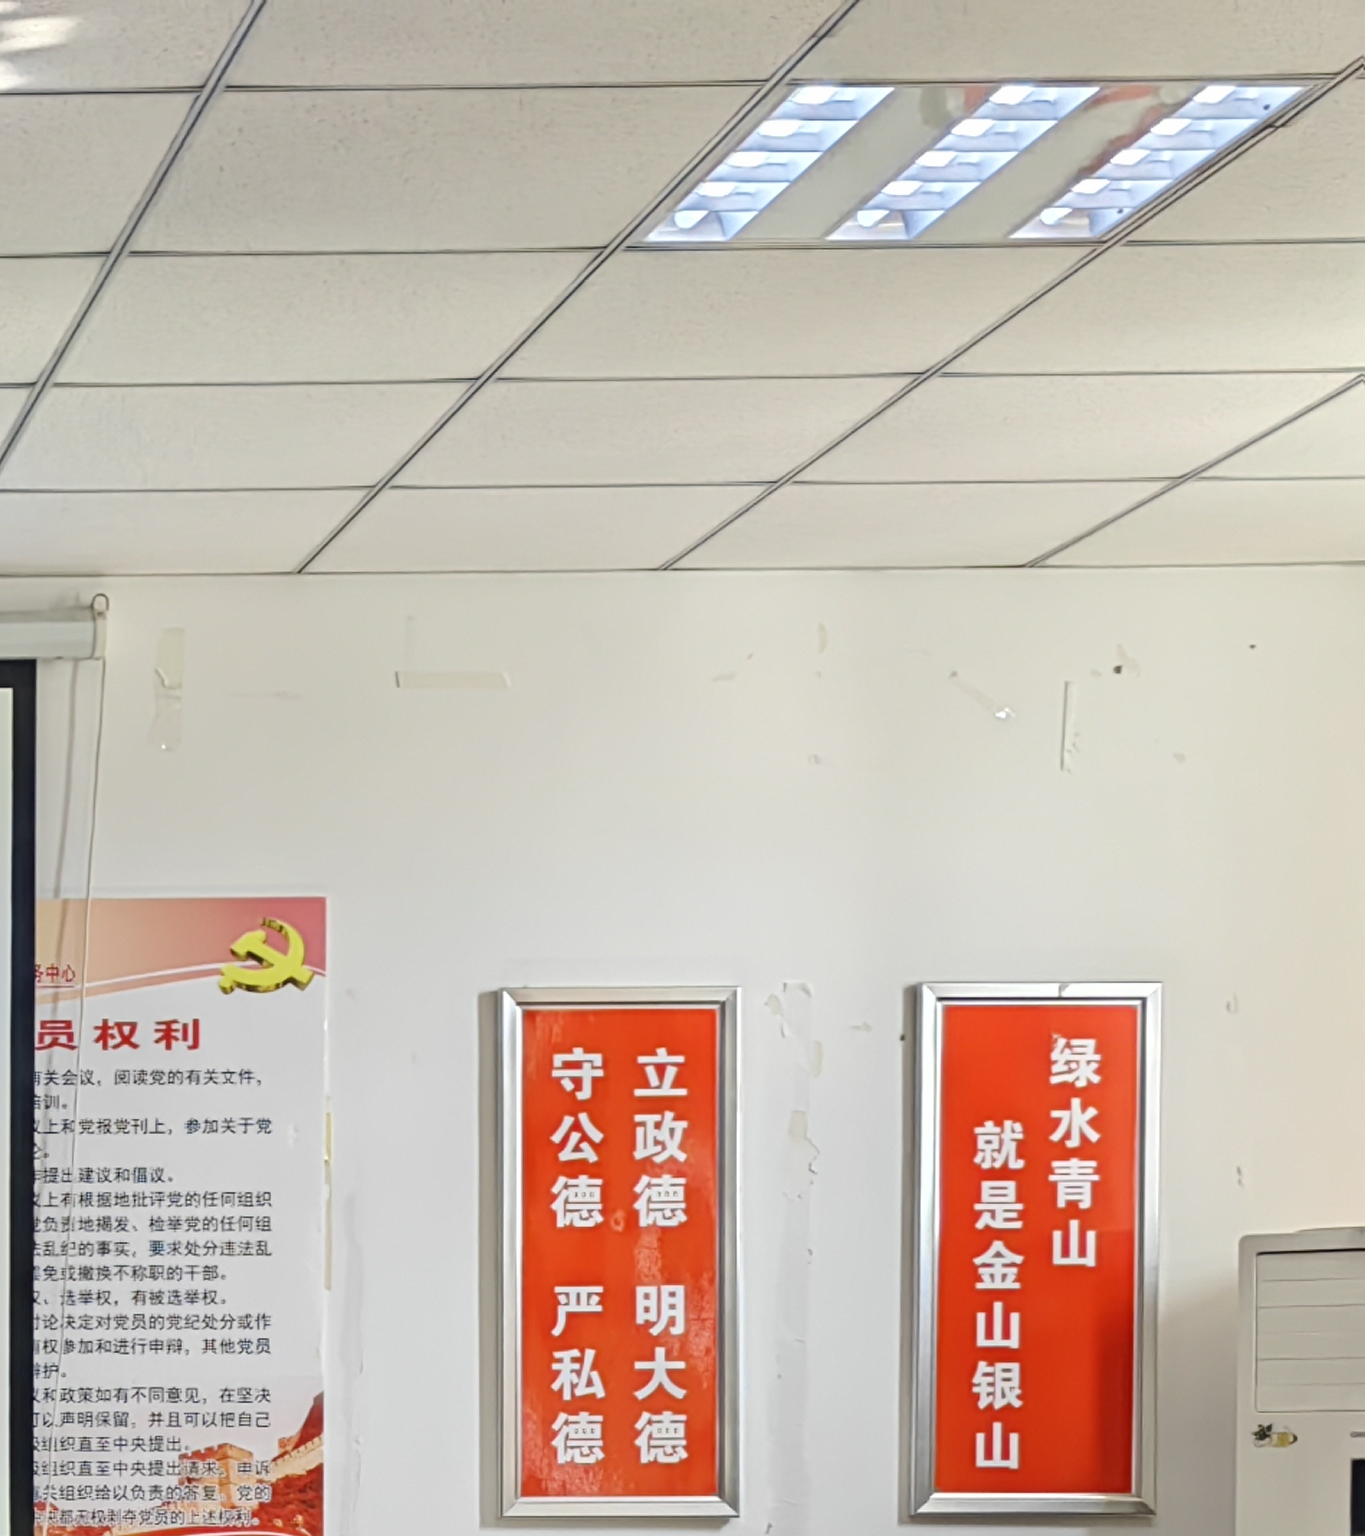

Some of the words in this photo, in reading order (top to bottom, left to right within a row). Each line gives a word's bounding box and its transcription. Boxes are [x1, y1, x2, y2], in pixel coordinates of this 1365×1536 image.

[34, 1018, 200, 1051] 员权利
[550, 1048, 604, 1228] 守公德
[633, 1047, 688, 1228] 立政德
[1048, 1034, 1101, 1268] 绿水青山
[550, 1284, 605, 1464] 严私德
[633, 1284, 688, 1464] 明大德
[972, 1119, 1025, 1470] 就是金山银山
